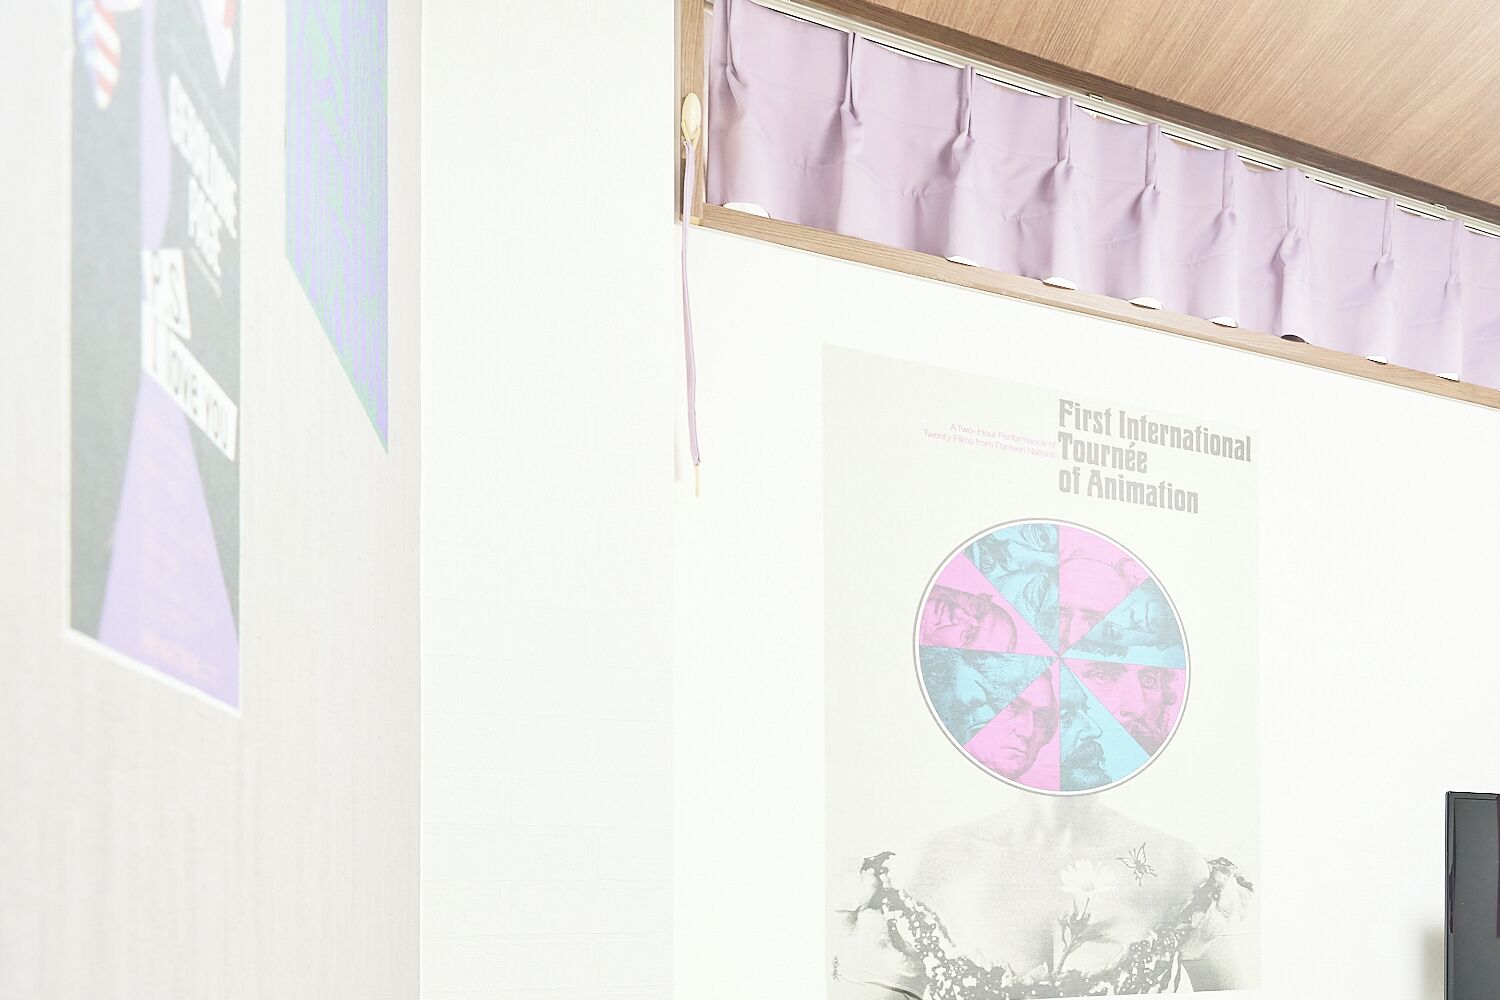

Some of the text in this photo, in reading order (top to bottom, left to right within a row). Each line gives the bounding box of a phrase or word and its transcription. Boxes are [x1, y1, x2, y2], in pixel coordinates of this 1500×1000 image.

[924, 428, 1057, 459] Twenty Films from Thirteen Nations
[1057, 431, 1148, 474] Tournée
[1058, 398, 1252, 463] First International
[1058, 466, 1199, 514] of Animation
